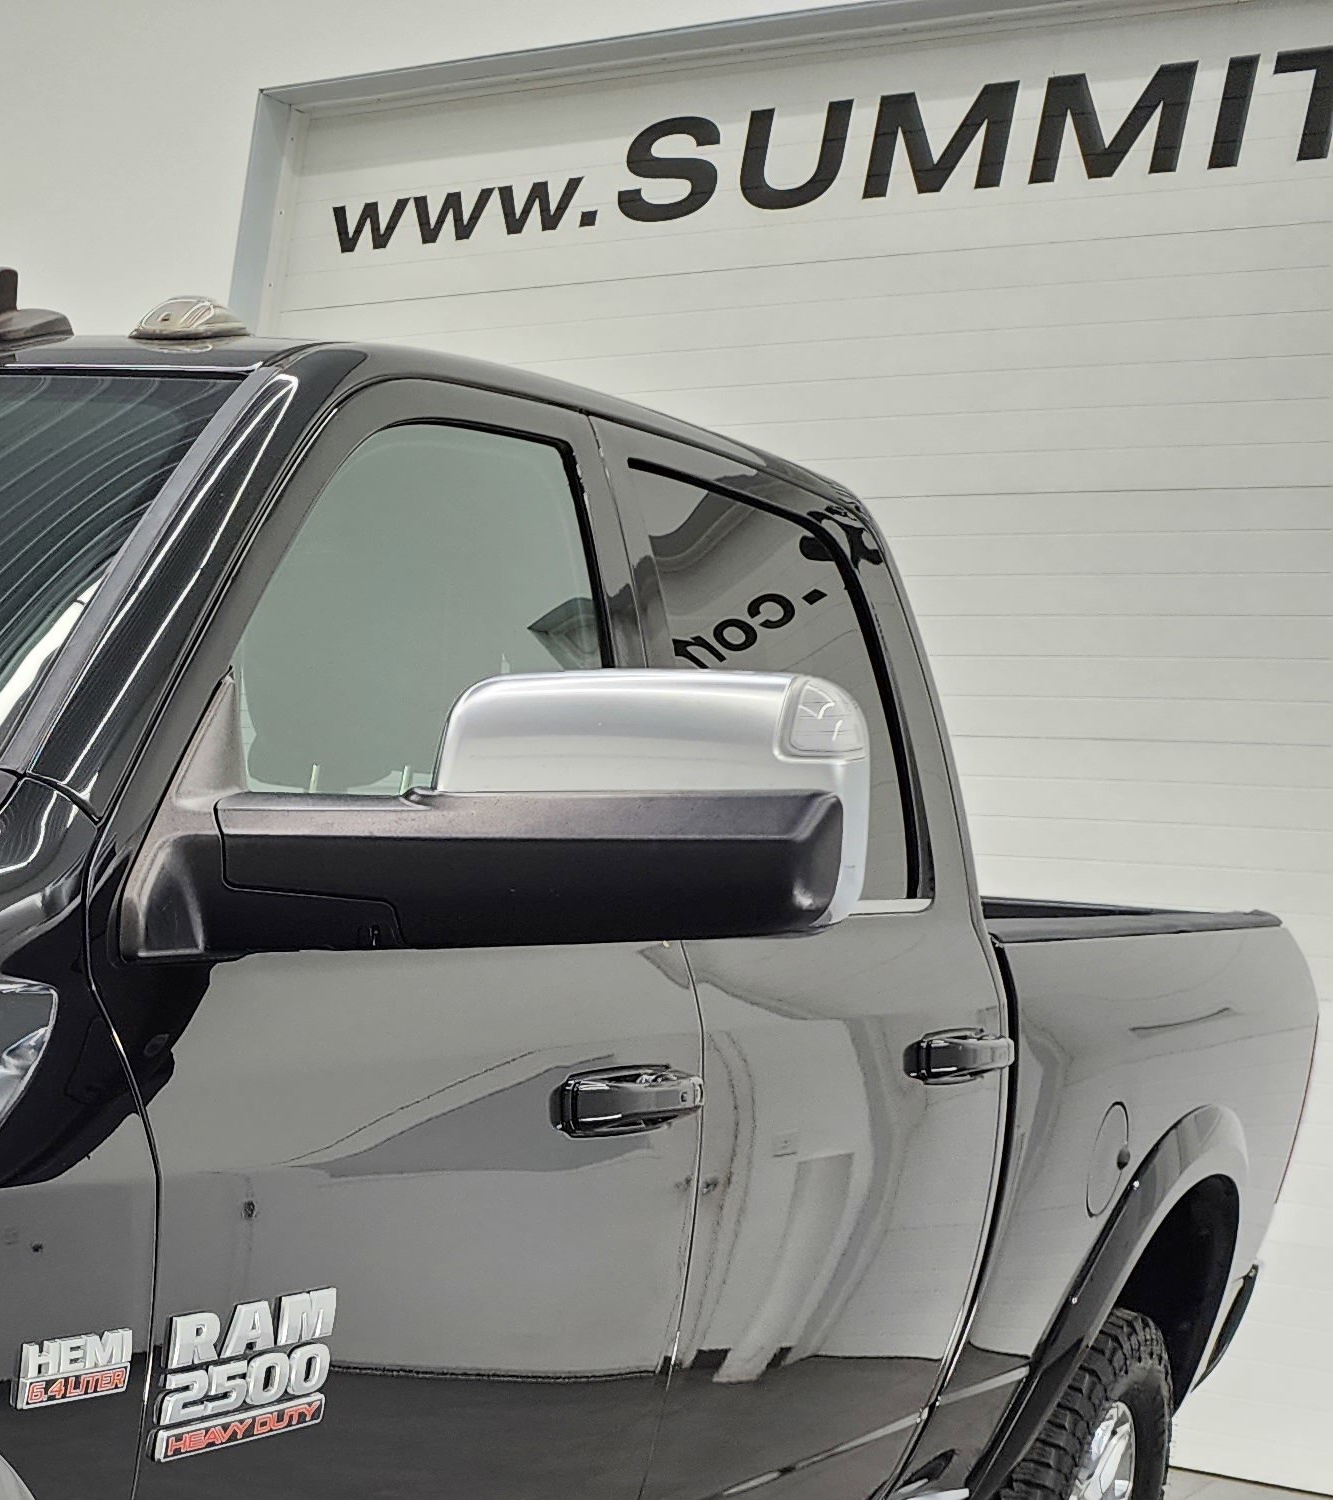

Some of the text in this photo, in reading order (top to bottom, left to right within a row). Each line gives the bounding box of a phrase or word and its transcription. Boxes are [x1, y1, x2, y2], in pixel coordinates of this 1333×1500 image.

[21, 1328, 133, 1378] HEMI
[169, 1287, 337, 1369] RAM
[66, 1368, 126, 1398] LITER
[158, 1343, 332, 1426] 2500
[167, 1402, 320, 1456] HEAVY DUTY
